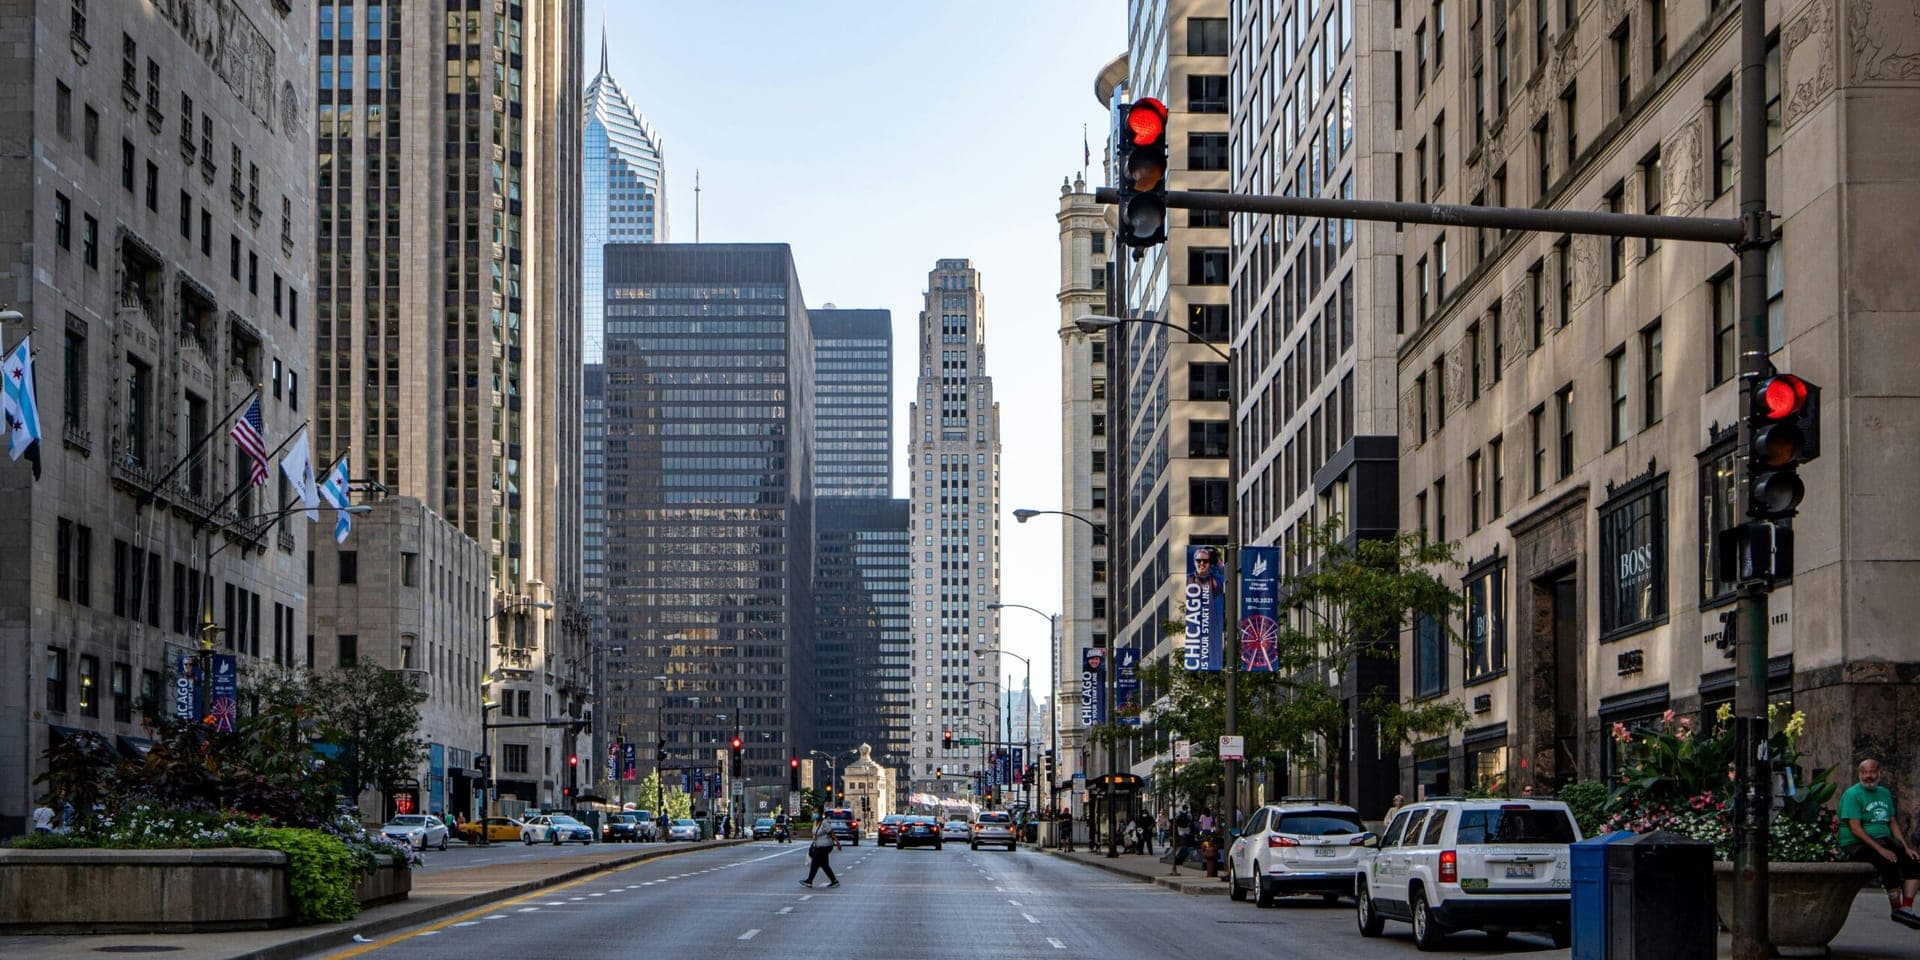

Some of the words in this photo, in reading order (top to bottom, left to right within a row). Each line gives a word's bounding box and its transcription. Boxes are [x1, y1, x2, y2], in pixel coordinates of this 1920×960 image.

[1620, 543, 1652, 580] BOSS
[1184, 583, 1201, 670] CHICAGO
[1201, 607, 1209, 634] START
[1201, 636, 1209, 659] YOUR
[1201, 661, 1209, 670] IS
[177, 678, 188, 720] ICAGO
[1081, 671, 1092, 726] CHICAGO
[1555, 861, 1568, 870] 42
